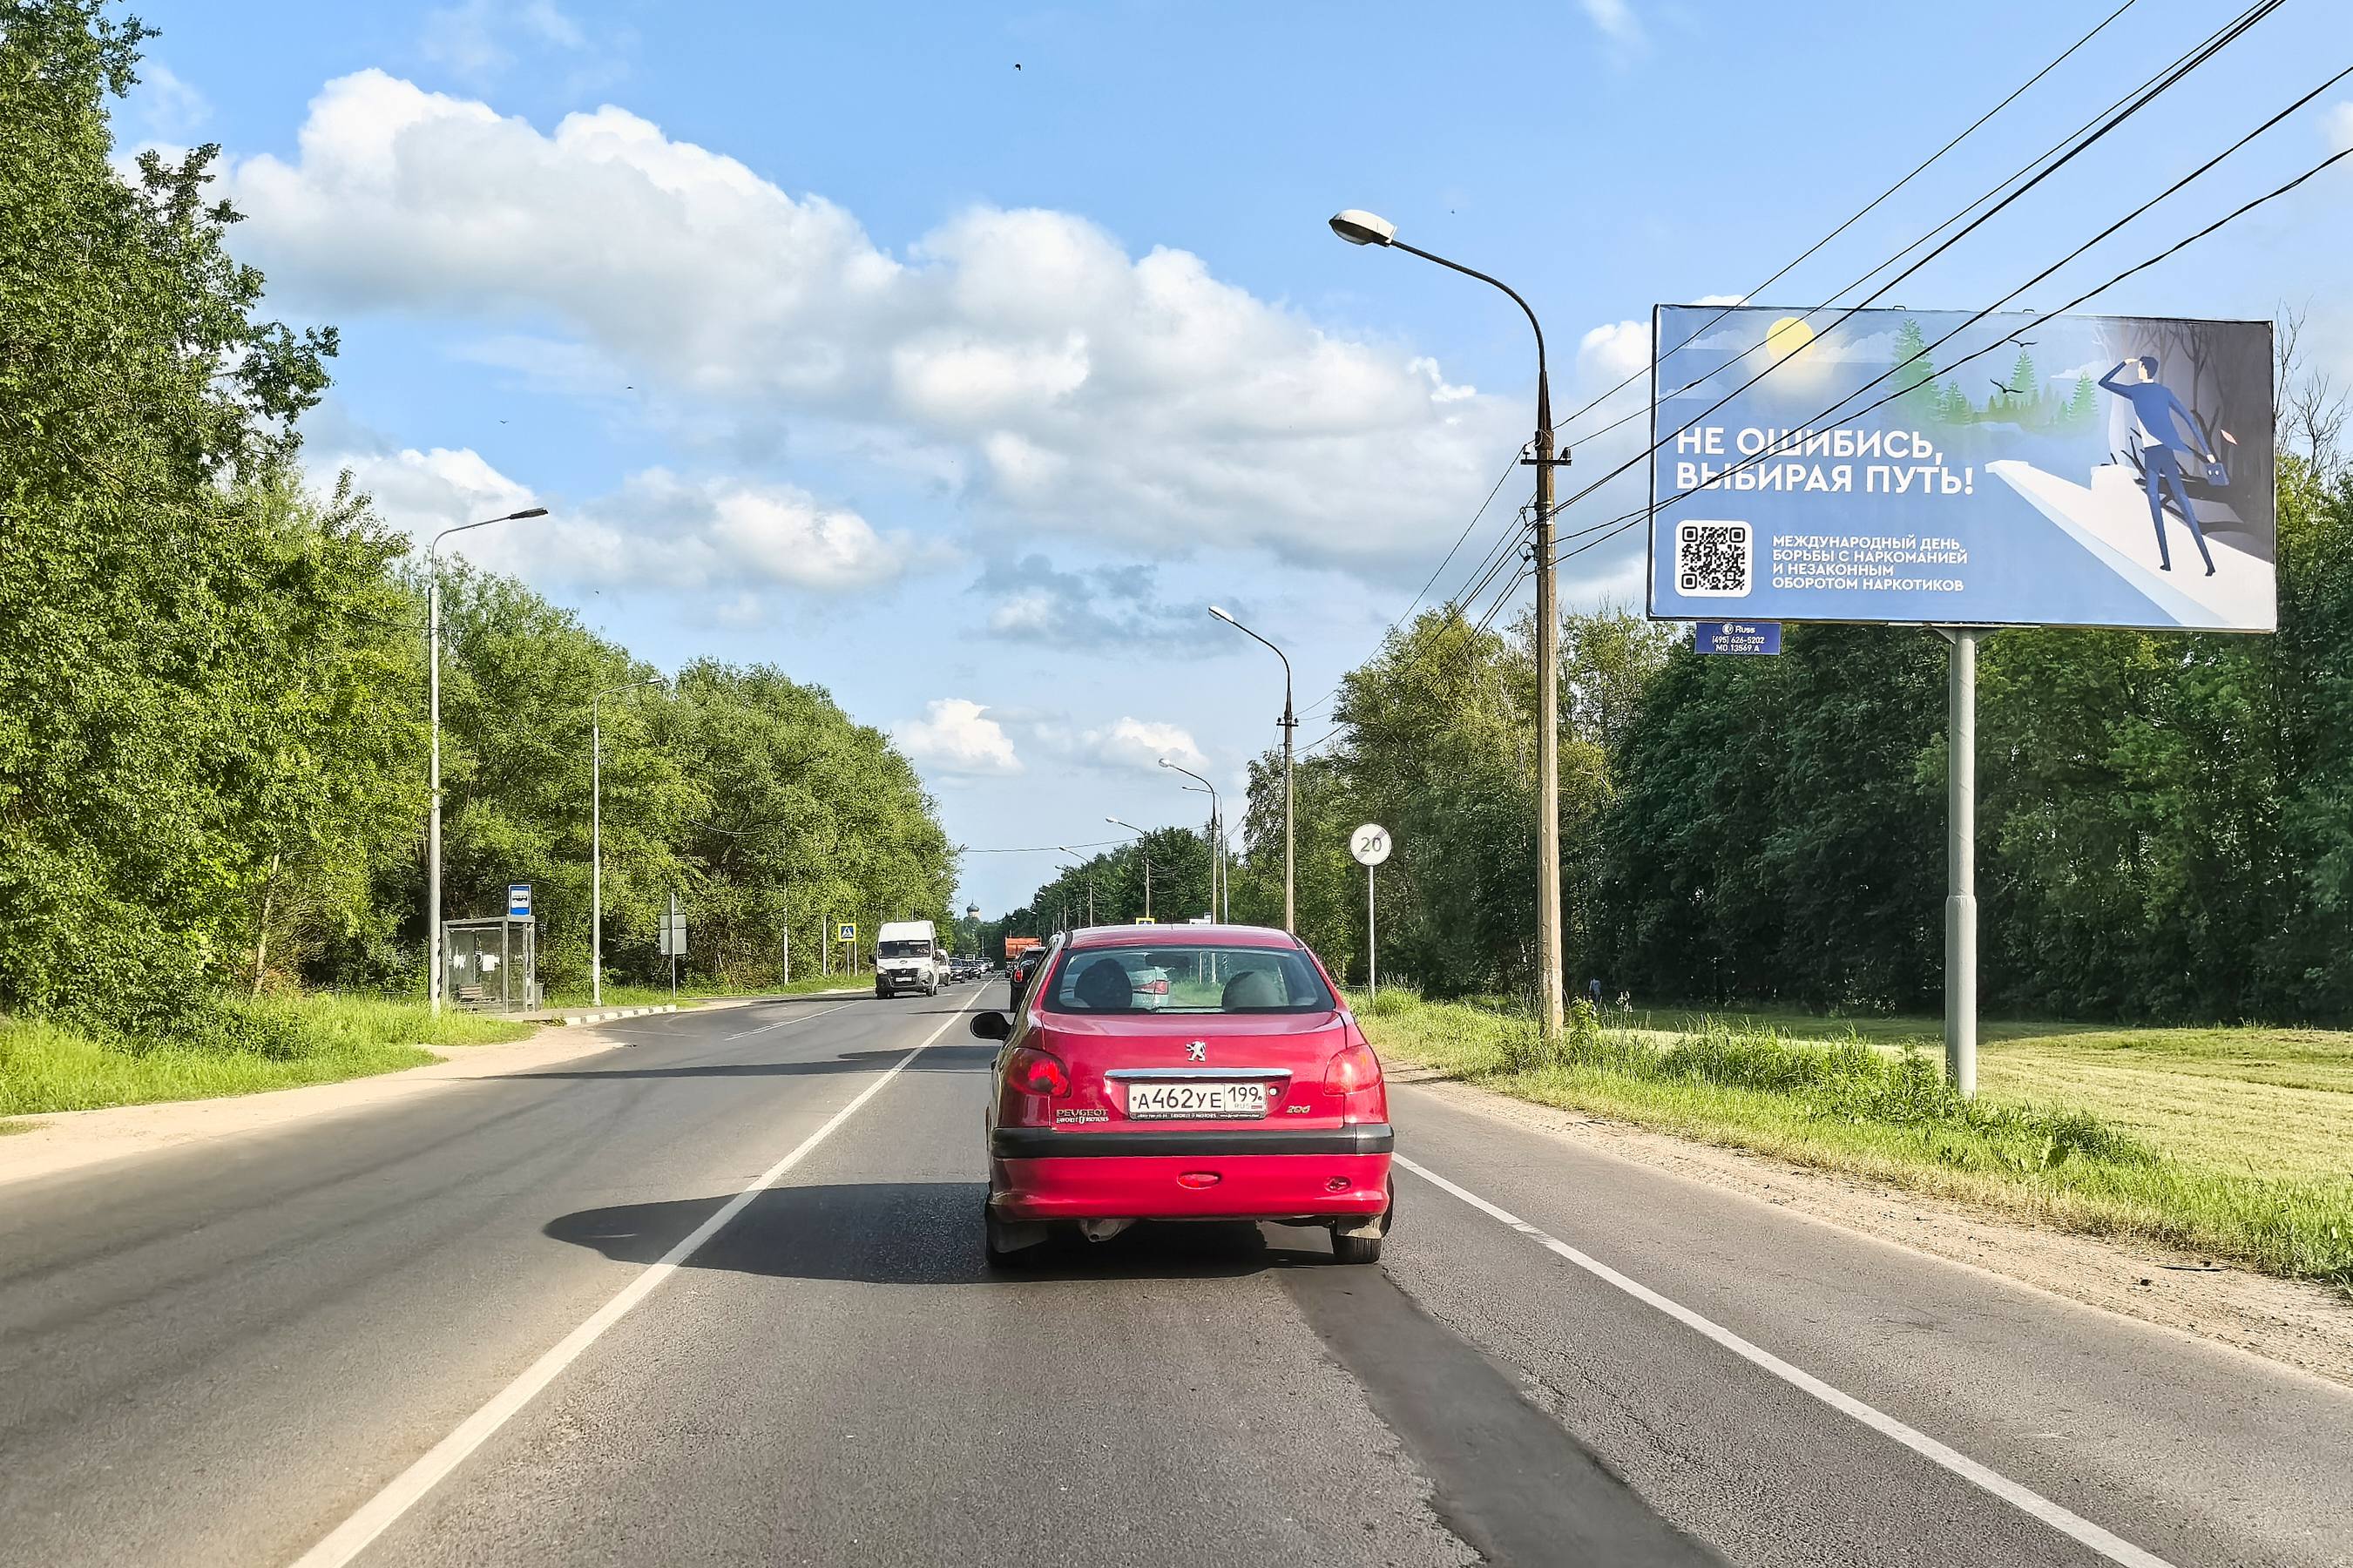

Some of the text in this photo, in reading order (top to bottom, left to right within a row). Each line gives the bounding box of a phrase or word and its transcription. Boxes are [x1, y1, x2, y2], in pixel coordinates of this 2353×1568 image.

[1677, 427, 1943, 466] НЕ ОШИБИСЬ,
[1676, 462, 1973, 496] ВЫБИРАЯ ПУТЬ!
[1772, 534, 1960, 551] МЕЖДУНАРОДНЫЙ ДЕНЬ
[1772, 549, 1968, 564] БОРЬБЫ С НАРКОМАНИЕЙ
[1772, 563, 1895, 577] И НЕЗАКОННЫМ
[1771, 577, 1964, 591] ОБОРОТОМ НАРКОТИКОВ
[1360, 836, 1383, 853] 20
[1227, 1086, 1259, 1103] 199
